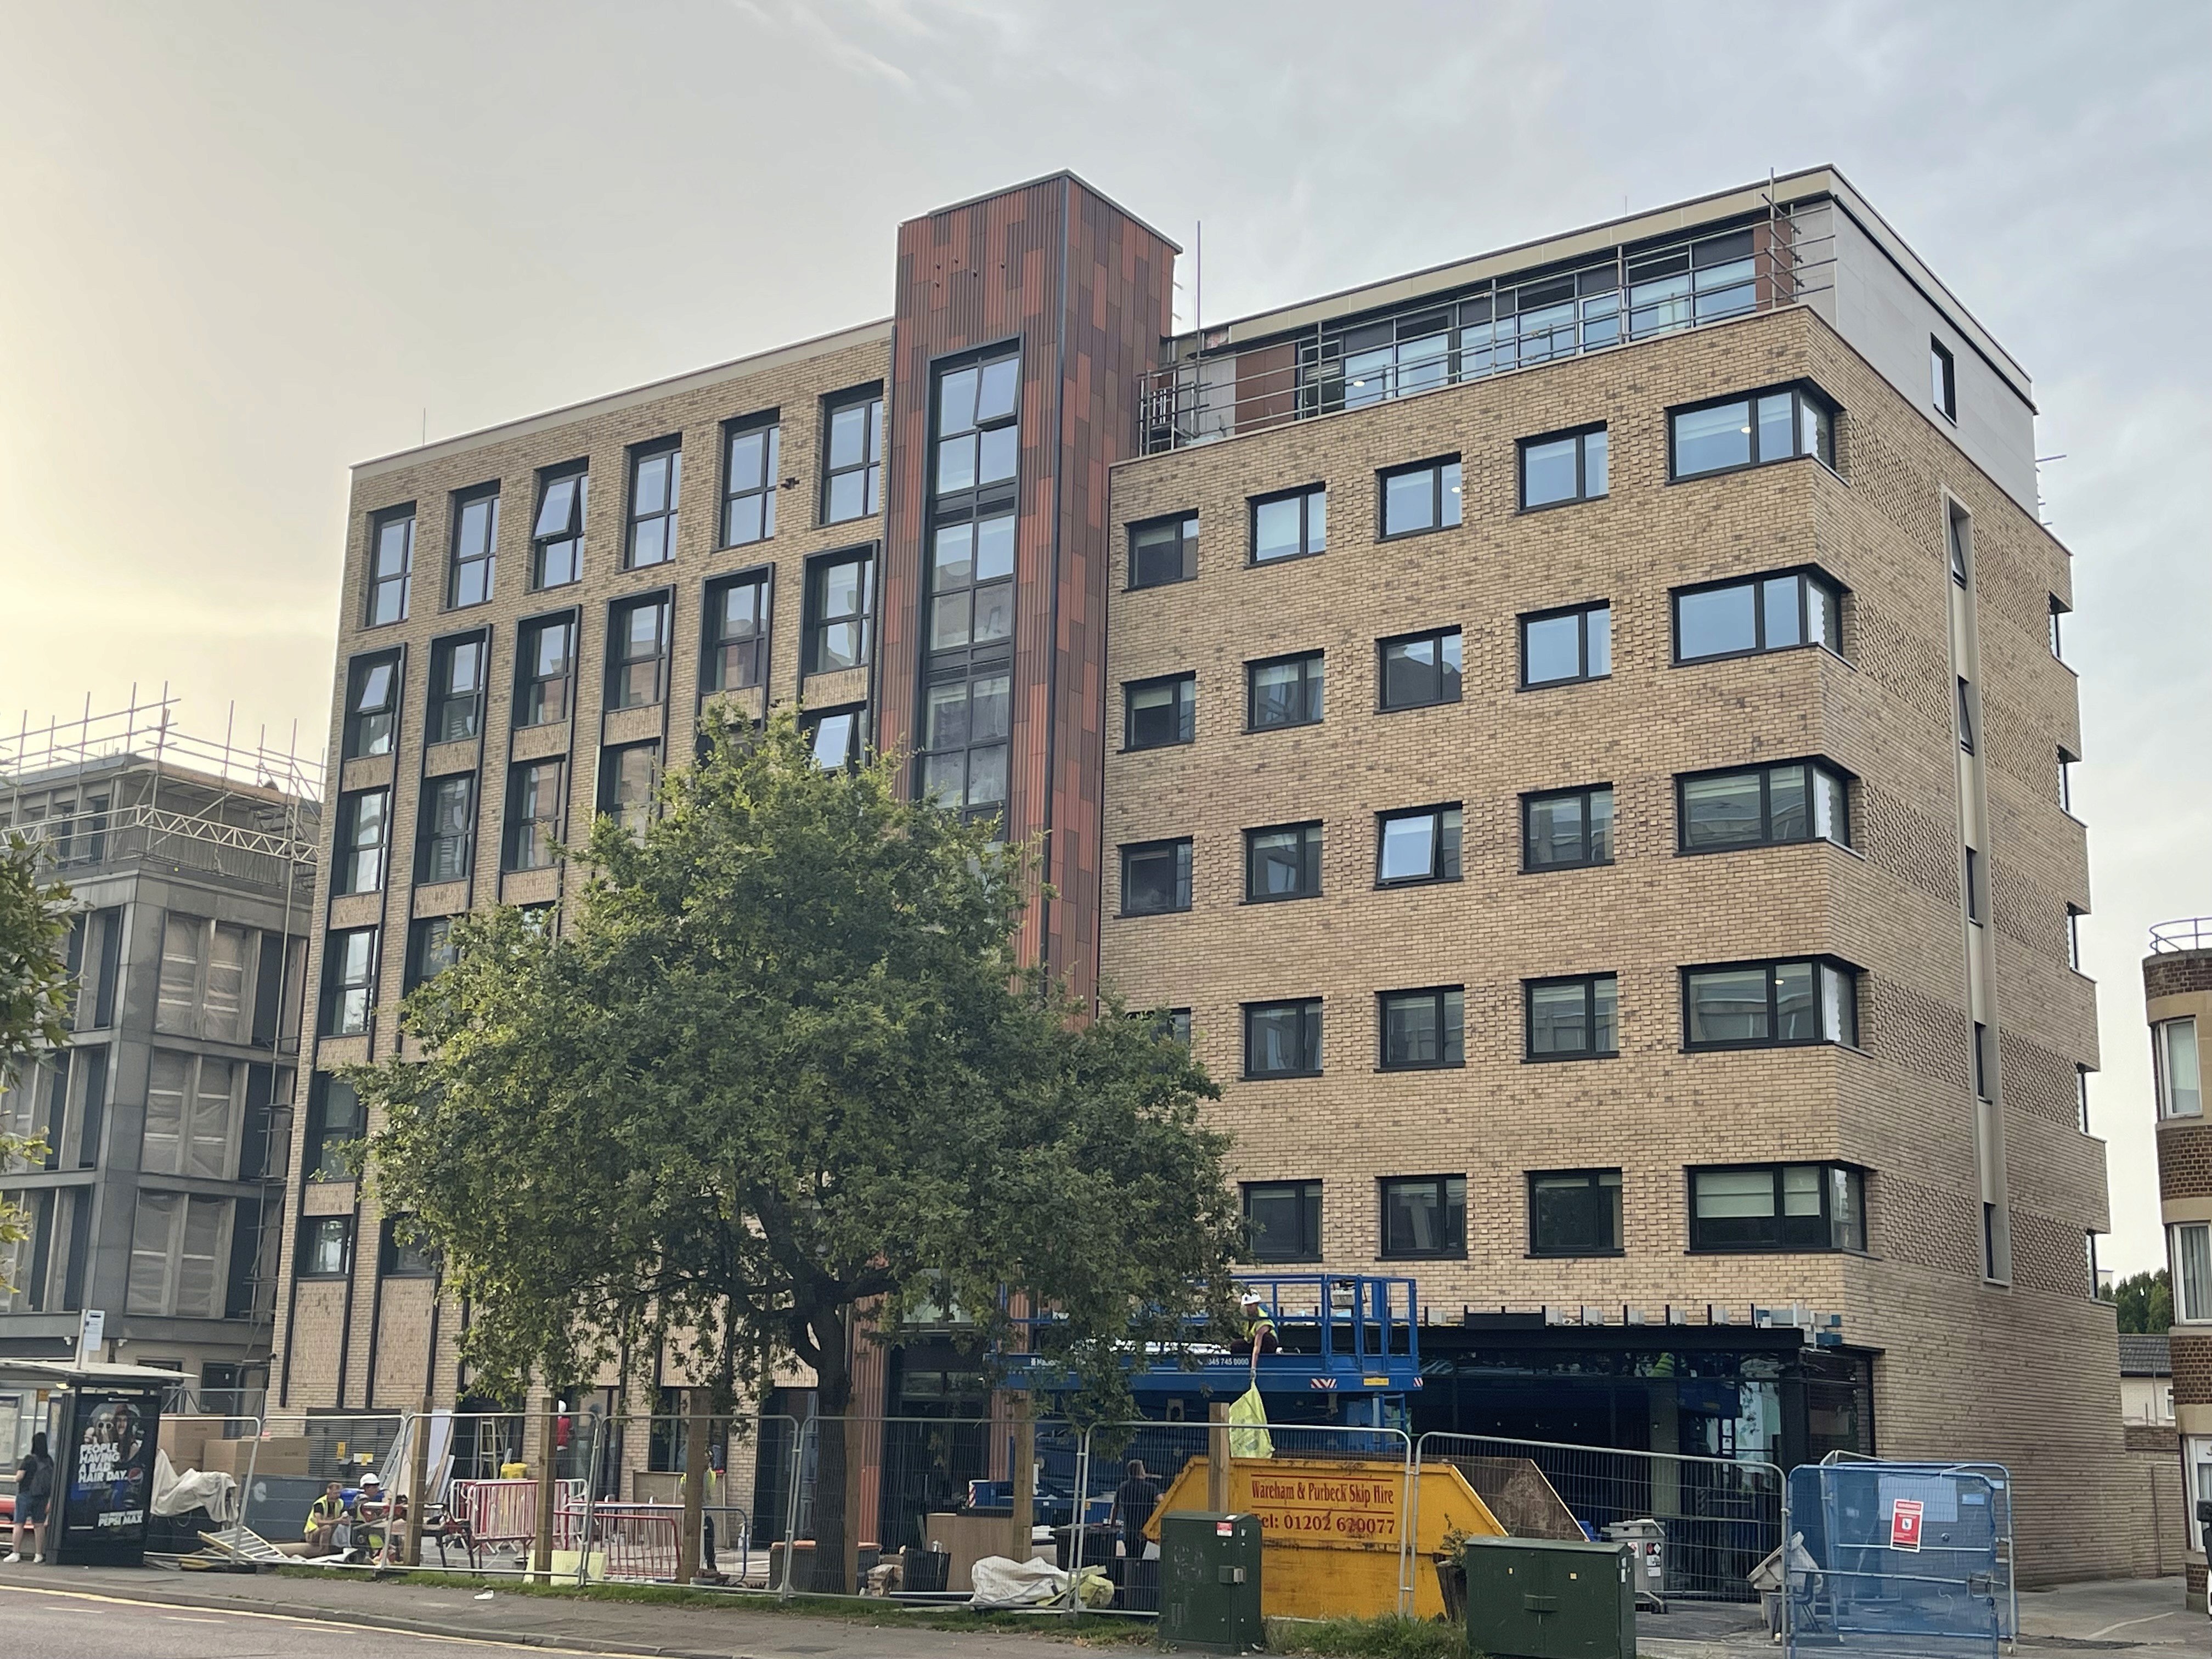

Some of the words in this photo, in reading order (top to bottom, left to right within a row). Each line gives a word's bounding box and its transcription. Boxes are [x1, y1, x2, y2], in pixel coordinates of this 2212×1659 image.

[80, 1443, 119, 1453] PEOPLE
[80, 1453, 120, 1464] HAVING
[79, 1464, 87, 1474] A
[89, 1463, 110, 1472] BAD
[78, 1472, 104, 1483] HAIR
[106, 1470, 128, 1481] DAY.
[1251, 1480, 1294, 1500] Wareham
[1297, 1482, 1305, 1499] &
[1308, 1482, 1347, 1502] Purbeck
[1349, 1484, 1371, 1508] Skip
[1373, 1485, 1394, 1504] Hire
[122, 1514, 143, 1525] MAX
[1284, 1514, 1331, 1531] 01202
[1336, 1516, 1395, 1534] 620077
